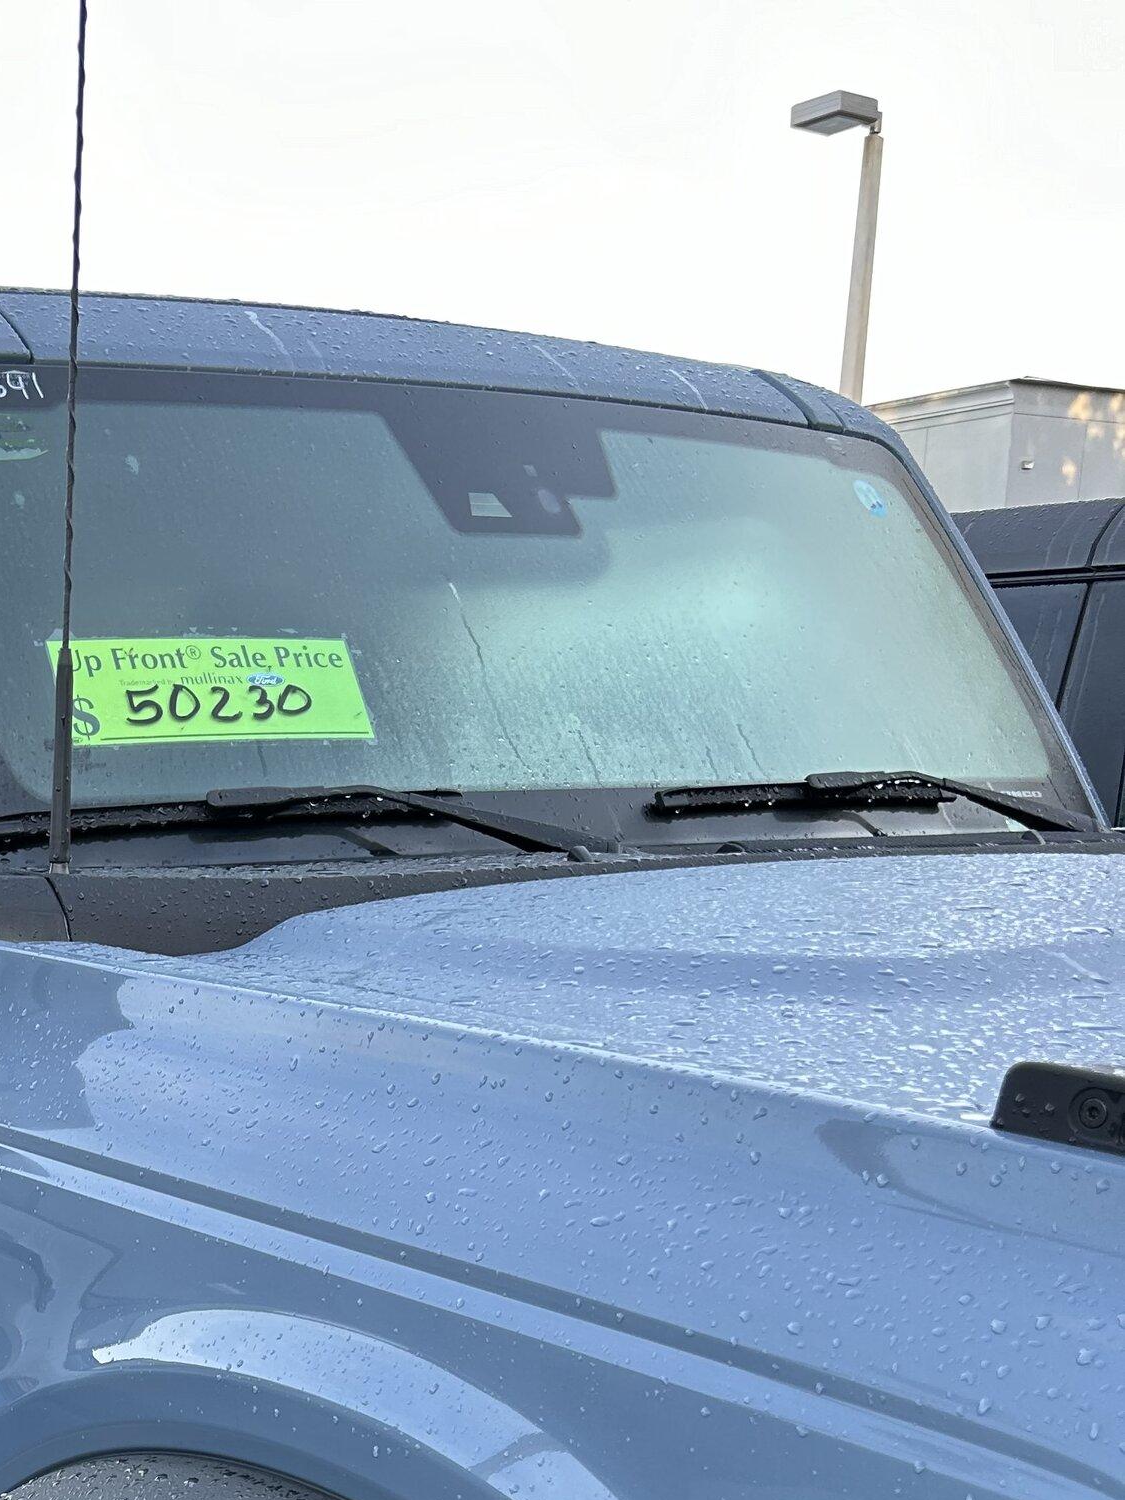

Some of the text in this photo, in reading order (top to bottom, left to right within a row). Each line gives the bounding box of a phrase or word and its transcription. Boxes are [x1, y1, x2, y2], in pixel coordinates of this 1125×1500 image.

[212, 644, 267, 668] Sale
[274, 645, 343, 668] Price
[180, 672, 244, 685] mullinax
[72, 683, 312, 739] $ 50230
